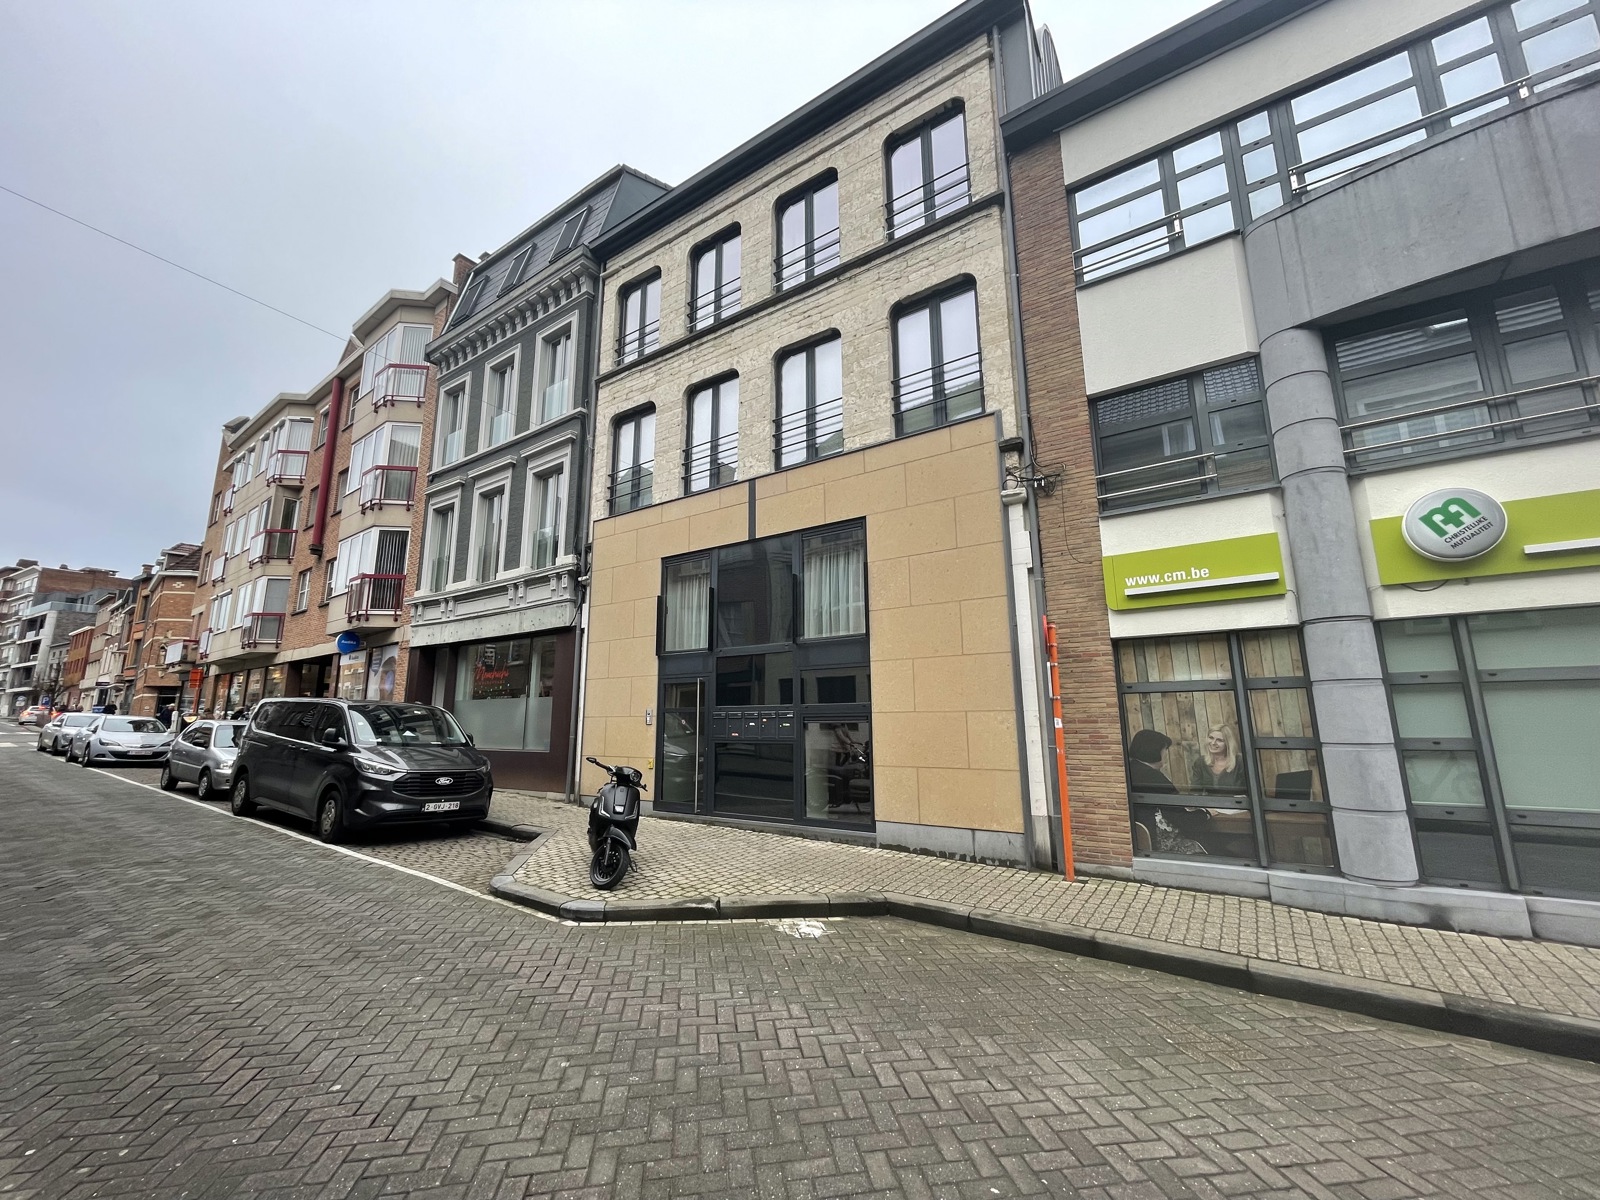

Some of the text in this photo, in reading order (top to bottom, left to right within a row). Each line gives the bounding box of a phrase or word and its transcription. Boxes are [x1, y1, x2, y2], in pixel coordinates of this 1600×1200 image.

[1444, 516, 1488, 543] CHRISTELIJKE
[1450, 522, 1494, 549] MUTUALITEIT
[1125, 567, 1209, 586] www.cm.be
